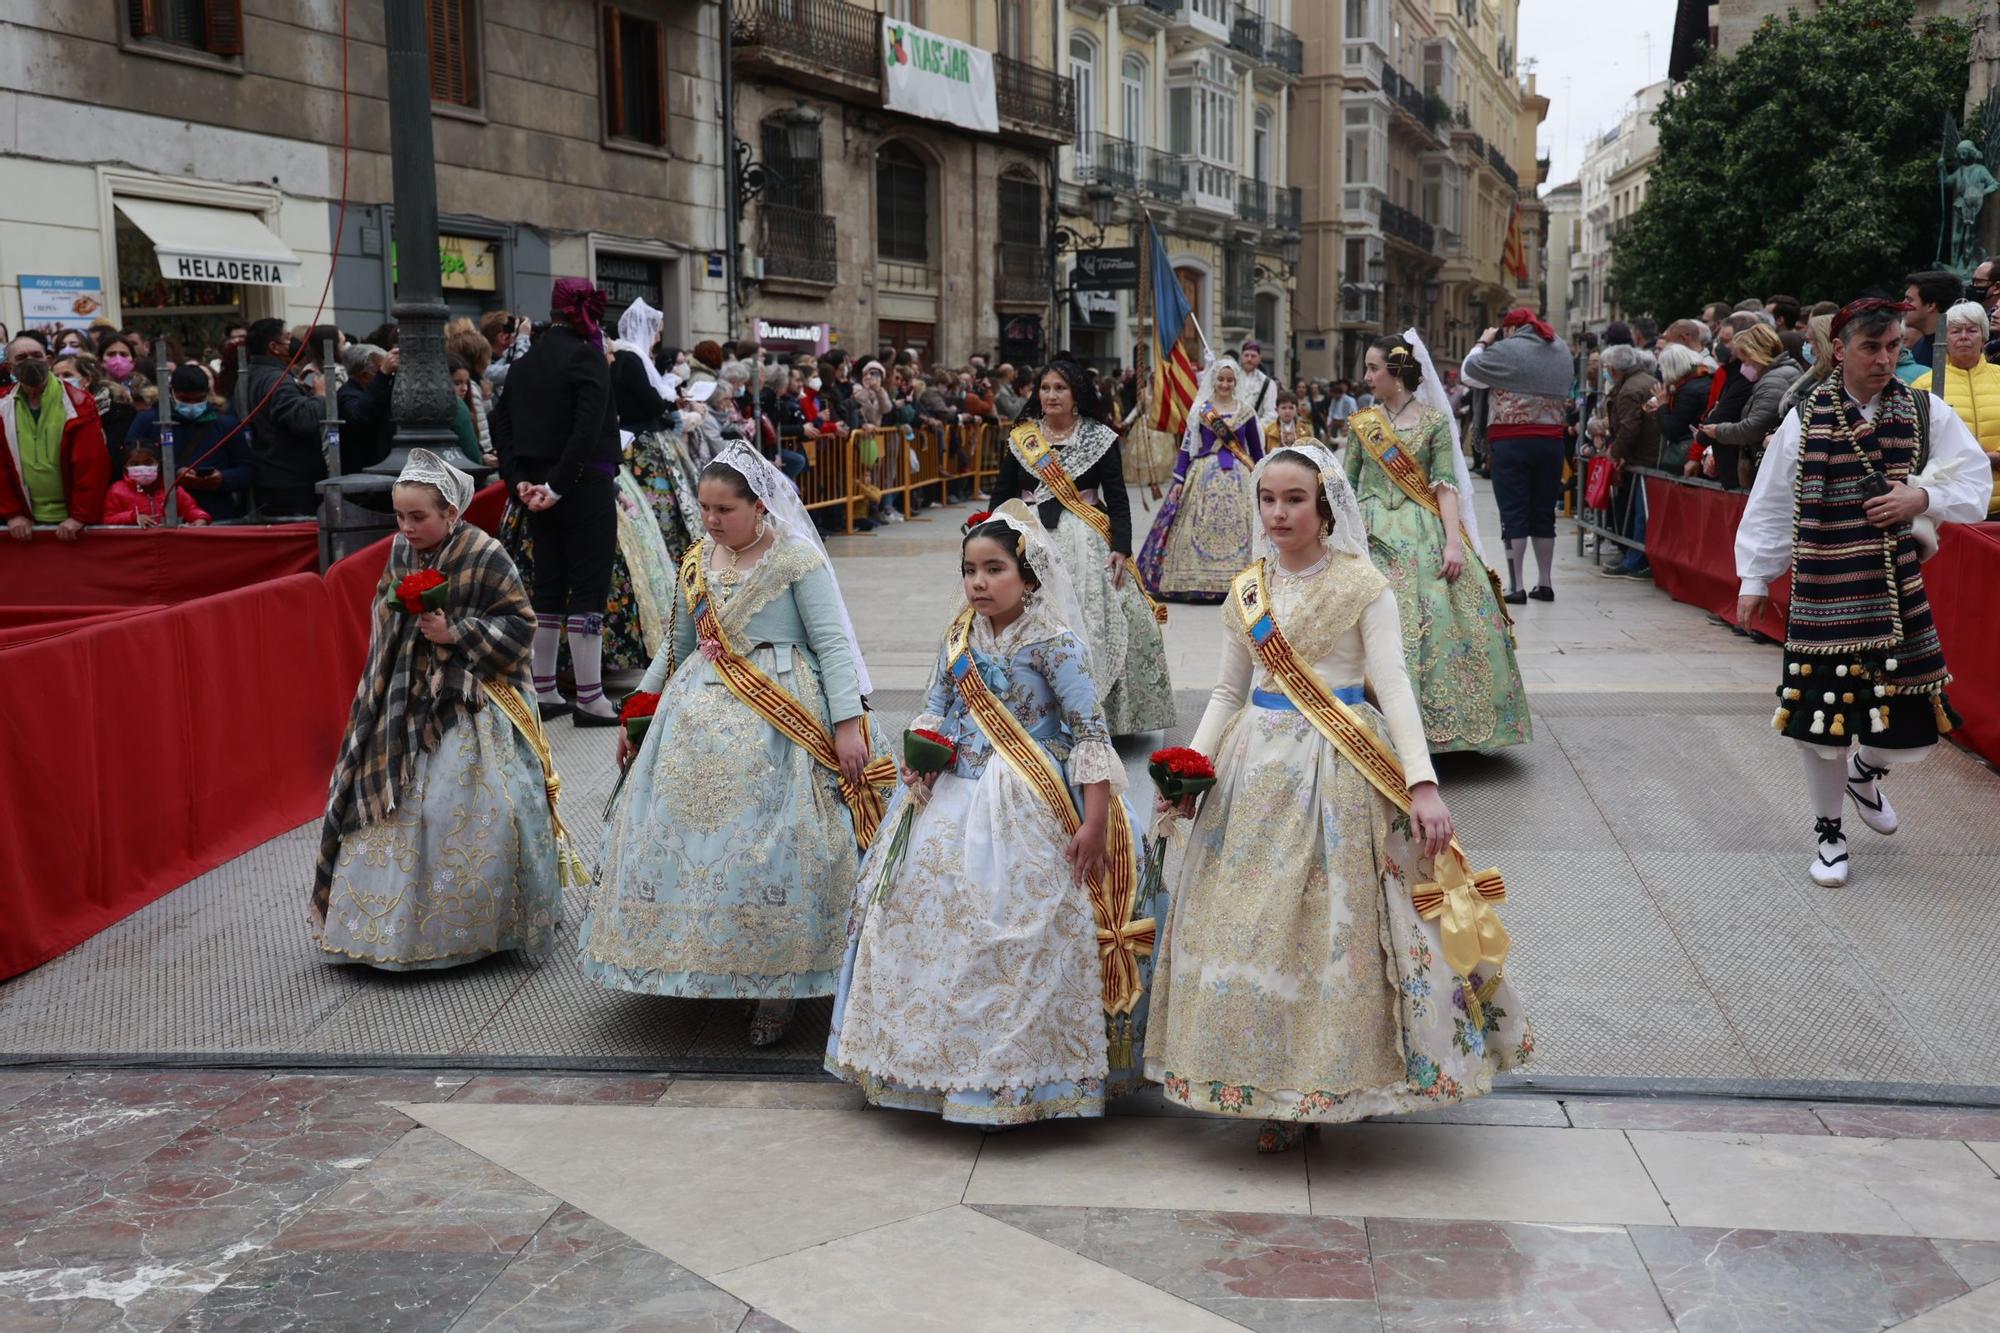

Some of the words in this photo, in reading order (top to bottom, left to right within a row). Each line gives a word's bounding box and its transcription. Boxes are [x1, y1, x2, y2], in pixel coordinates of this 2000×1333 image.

[178, 258, 282, 283] HELADERIA
[36, 278, 52, 287] nou
[769, 328, 778, 338] LA
